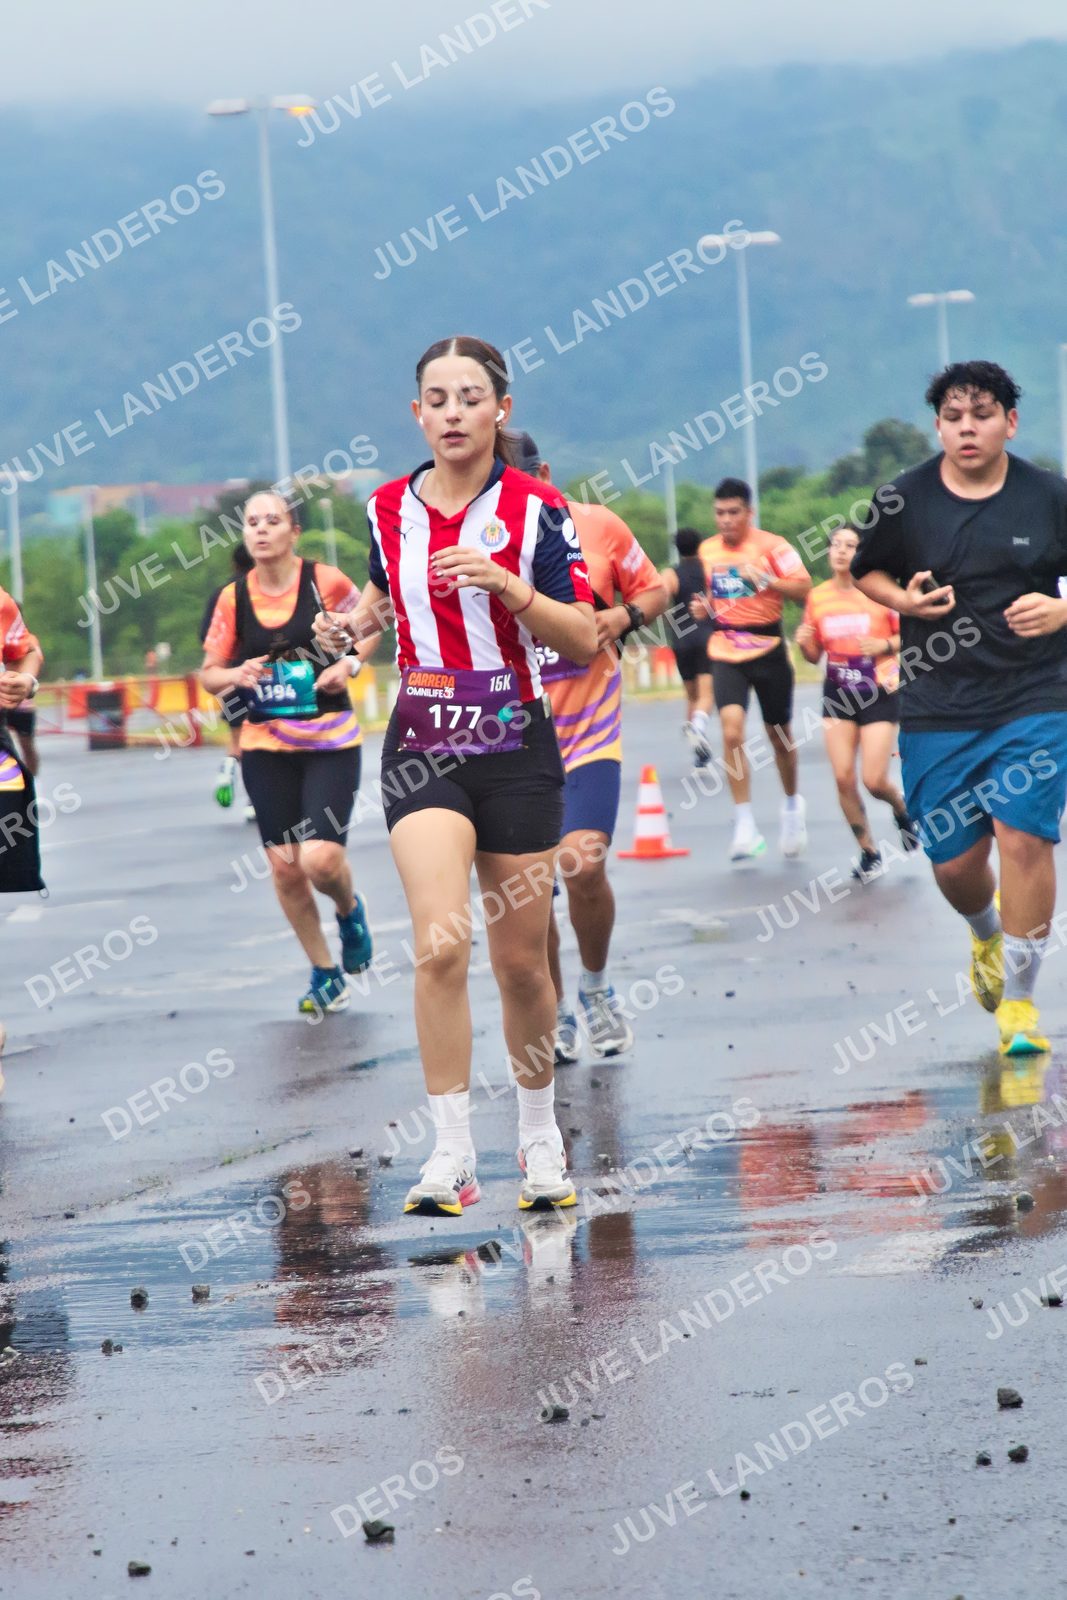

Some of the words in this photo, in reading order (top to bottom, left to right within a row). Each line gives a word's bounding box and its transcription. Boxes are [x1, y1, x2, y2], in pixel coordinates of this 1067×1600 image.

[566, 552, 584, 561] pep
[408, 672, 455, 688] CARRERA
[428, 704, 482, 729] 177
